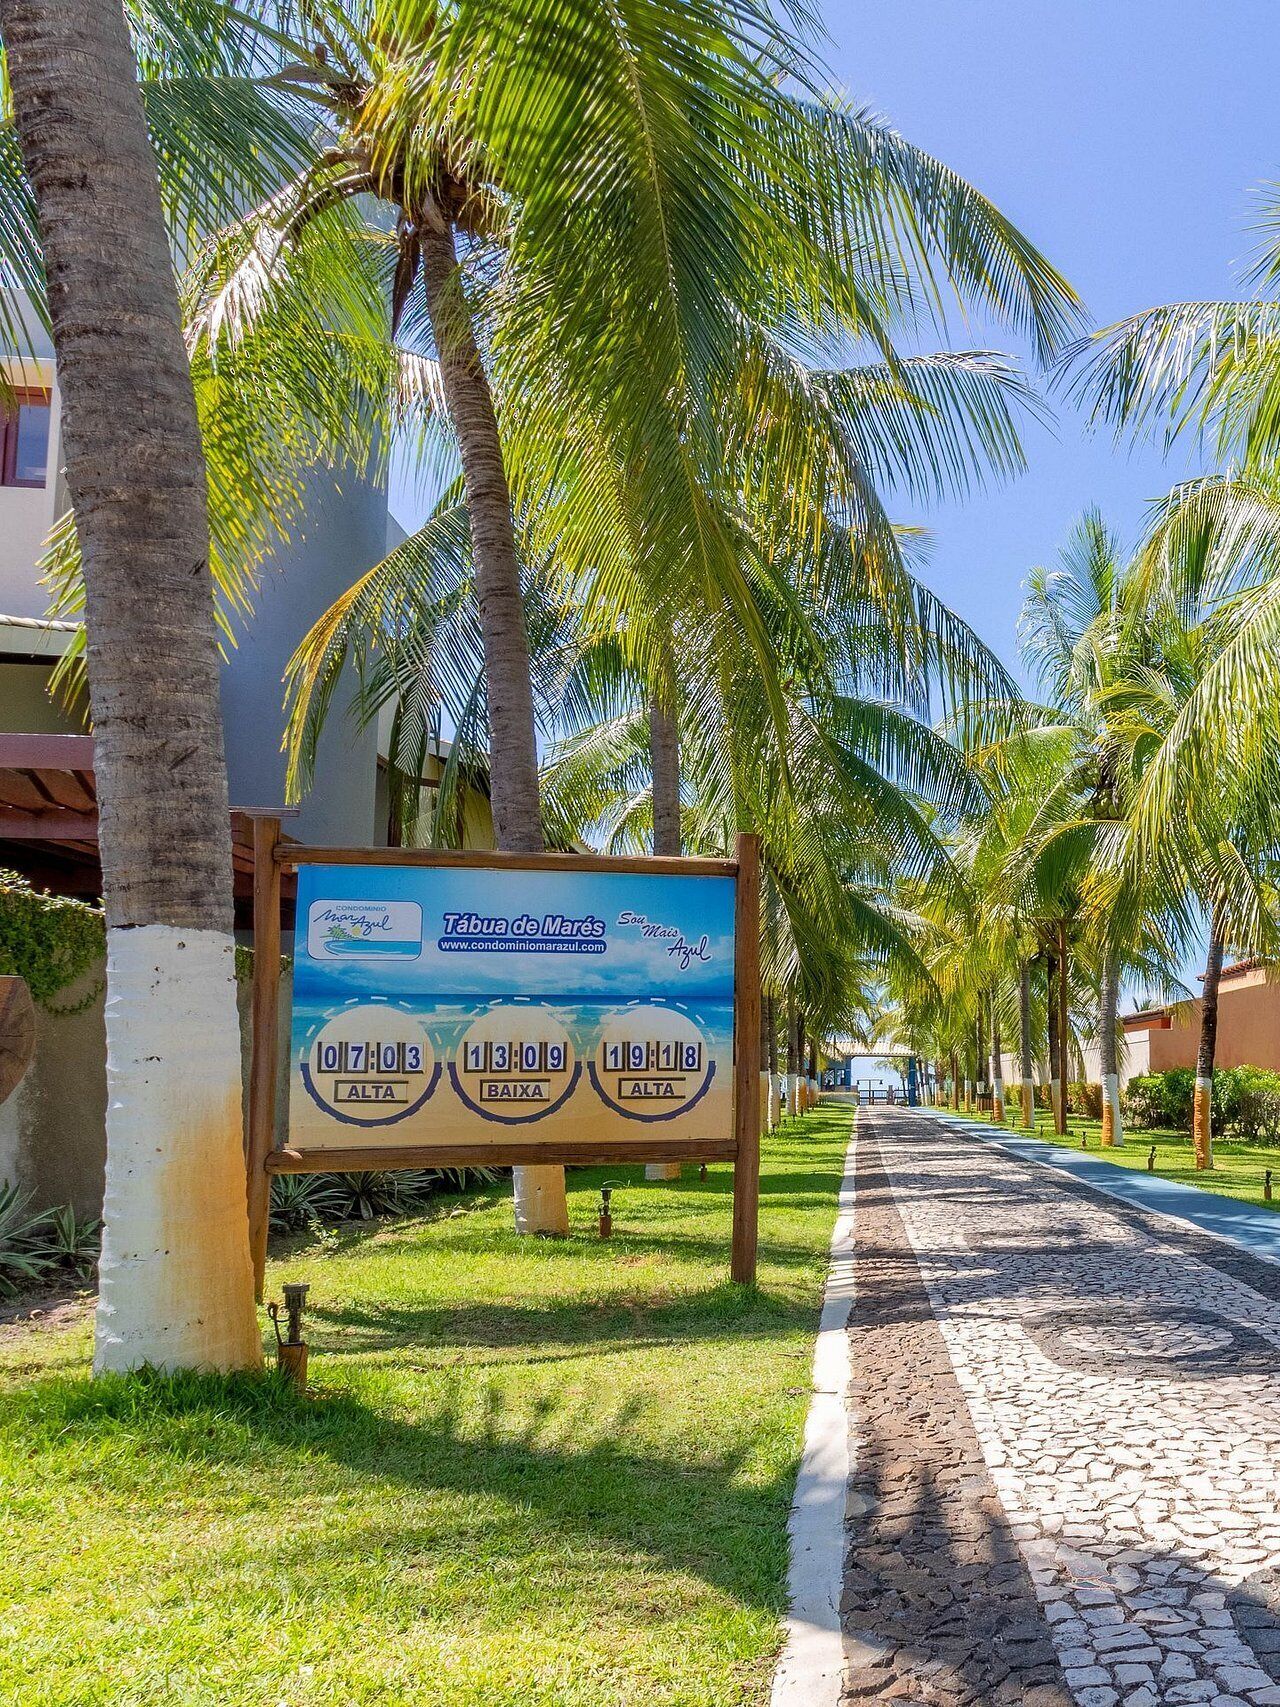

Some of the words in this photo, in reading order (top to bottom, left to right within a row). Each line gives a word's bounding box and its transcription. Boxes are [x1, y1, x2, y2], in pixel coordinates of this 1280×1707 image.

[313, 909, 359, 923] Mar
[350, 914, 392, 936] Azul
[444, 914, 507, 934] Tábua
[512, 916, 539, 935] de
[543, 916, 604, 936] Marés
[618, 912, 645, 925] Sou
[642, 924, 679, 938] Mais
[441, 940, 604, 953] www.condominiomarazul.com
[667, 936, 711, 970] Azul
[347, 1085, 395, 1099] ALTA
[487, 1084, 544, 1098] BAIXA
[630, 1083, 675, 1096] ALTA
